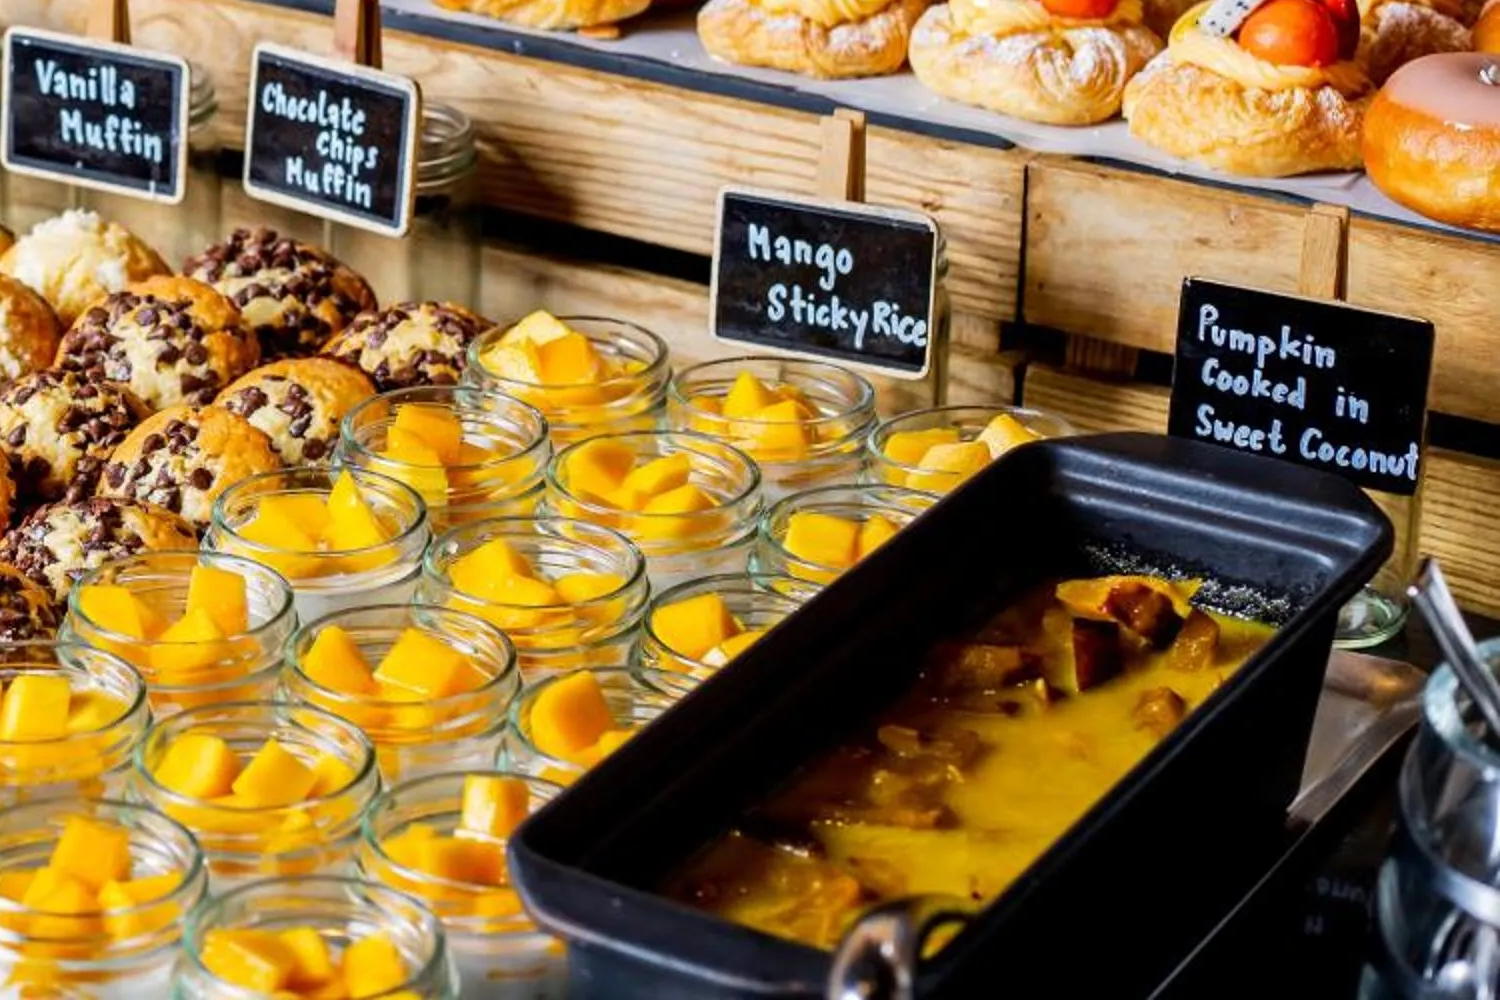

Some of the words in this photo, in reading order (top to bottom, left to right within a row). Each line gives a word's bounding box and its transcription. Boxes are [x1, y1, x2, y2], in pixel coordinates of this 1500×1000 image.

[34, 59, 136, 109] Vanilla
[262, 82, 367, 135] Chocolate
[60, 109, 163, 162] Muffin
[285, 156, 372, 208] Muffin
[748, 223, 854, 291] Mango
[1198, 303, 1336, 368] Pumpkin
[1201, 358, 1307, 410] Cooked
[1335, 387, 1369, 424] in
[1195, 404, 1287, 454] Sweet
[1299, 427, 1419, 481] Coconut
